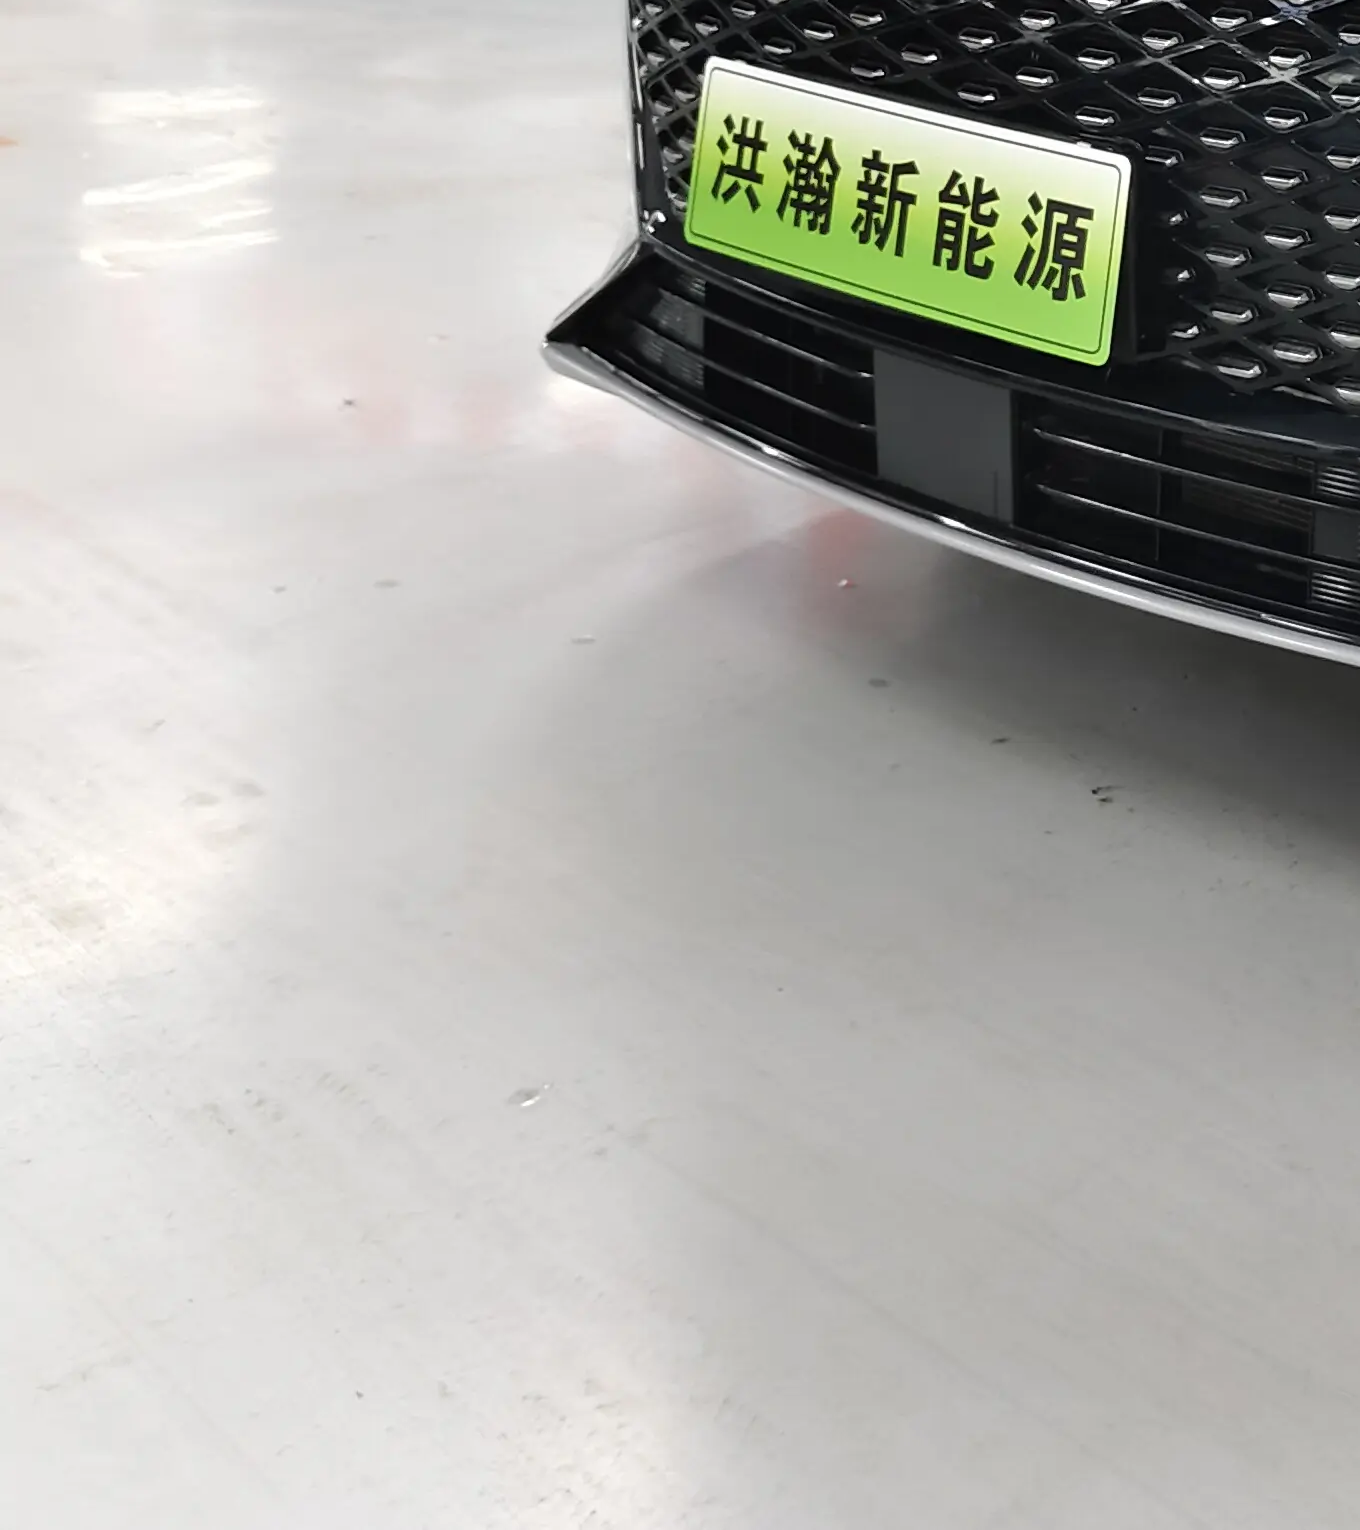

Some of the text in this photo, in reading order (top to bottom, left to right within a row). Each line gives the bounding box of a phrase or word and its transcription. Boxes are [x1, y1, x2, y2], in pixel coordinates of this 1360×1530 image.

[711, 113, 1095, 302] 洪瀚新能源
